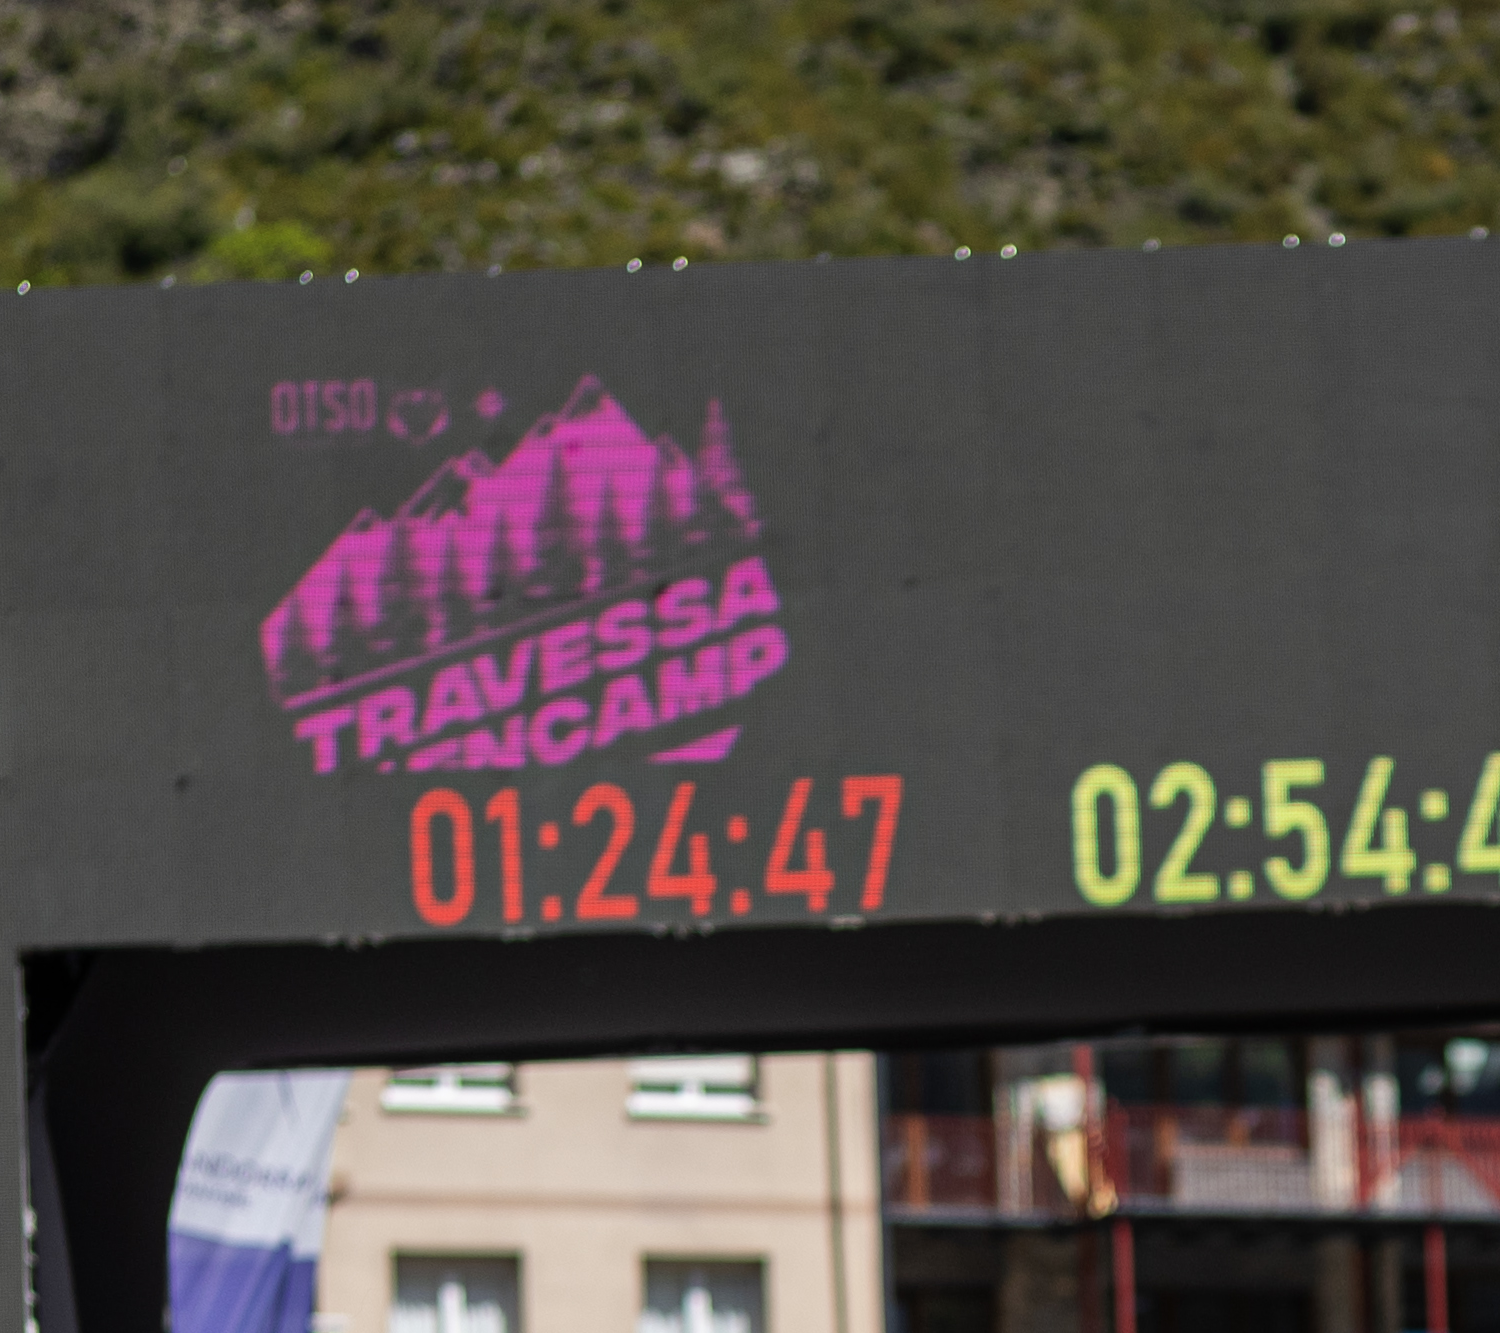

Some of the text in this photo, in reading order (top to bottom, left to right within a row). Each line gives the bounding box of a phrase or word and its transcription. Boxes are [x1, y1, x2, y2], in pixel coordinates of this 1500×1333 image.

[271, 379, 377, 435] OTSO
[294, 556, 780, 774] TRAVESSA
[410, 775, 903, 926] 01:24:47
